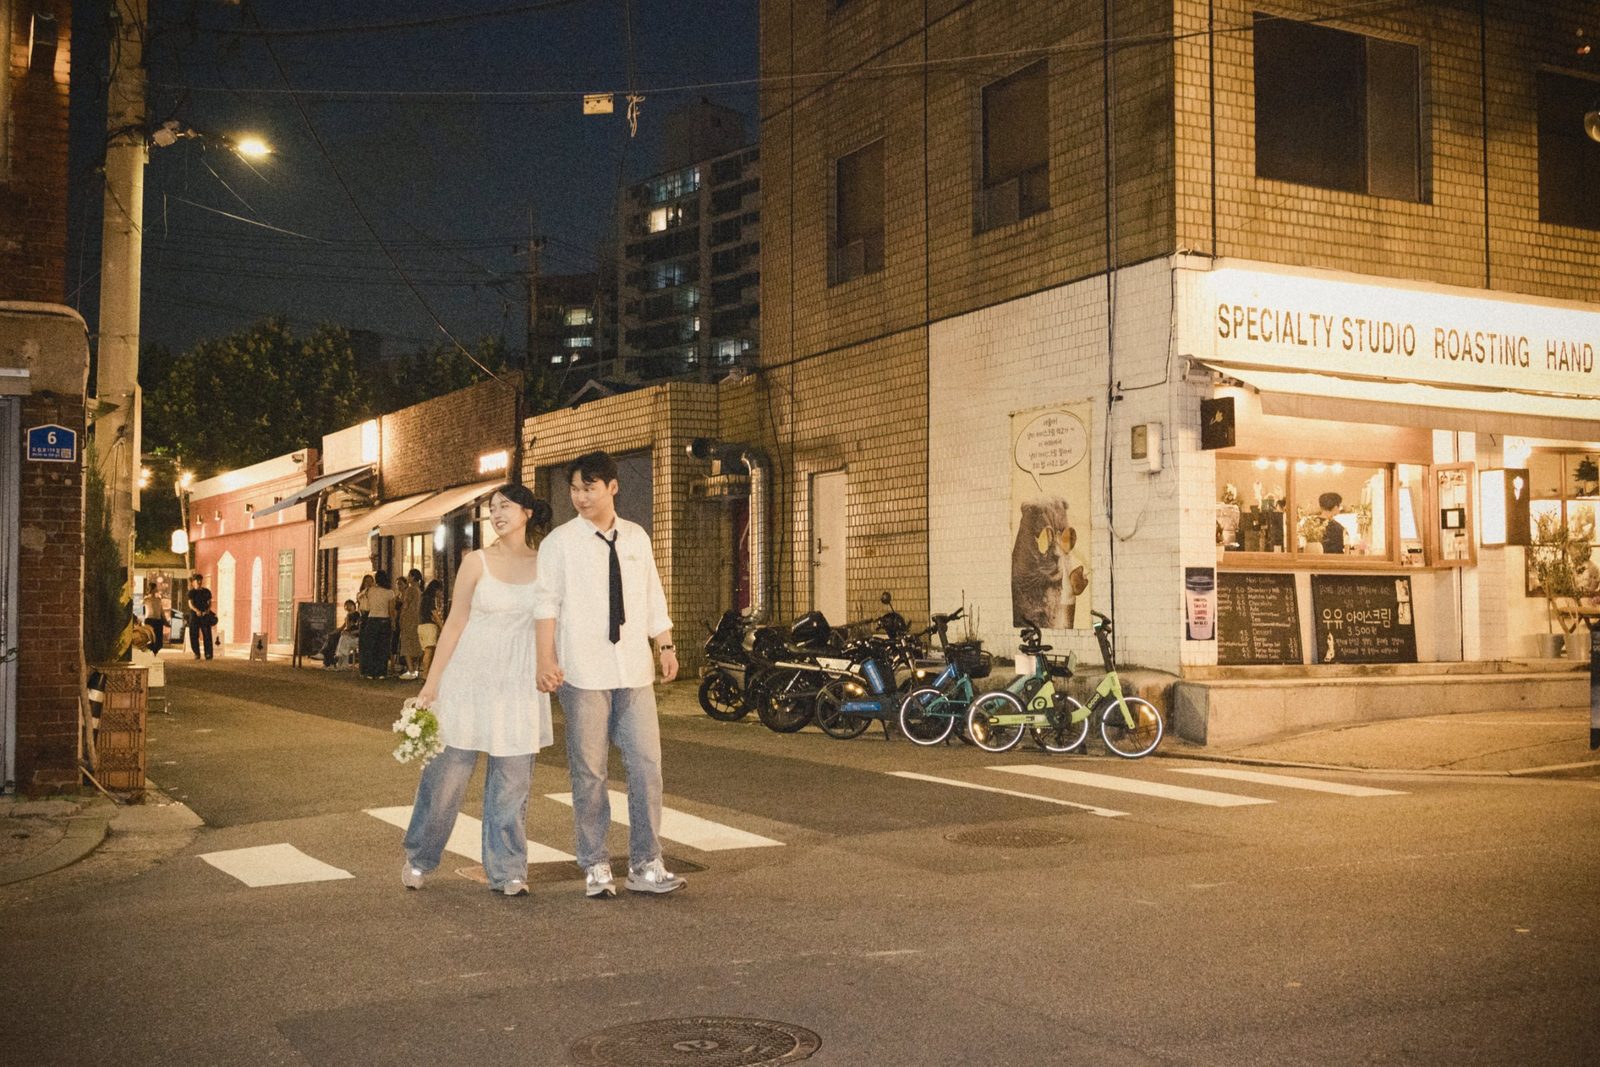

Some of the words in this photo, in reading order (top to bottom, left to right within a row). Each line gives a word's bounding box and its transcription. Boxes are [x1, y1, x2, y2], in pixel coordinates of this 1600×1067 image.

[1218, 303, 1334, 348] SPECIALTY
[1342, 316, 1416, 357] STUDIO
[1434, 327, 1529, 368] ROASTING
[1546, 340, 1594, 373] HAND
[47, 431, 57, 445] 6
[1323, 608, 1344, 630] 우유
[1346, 608, 1391, 628] 아이스크림
